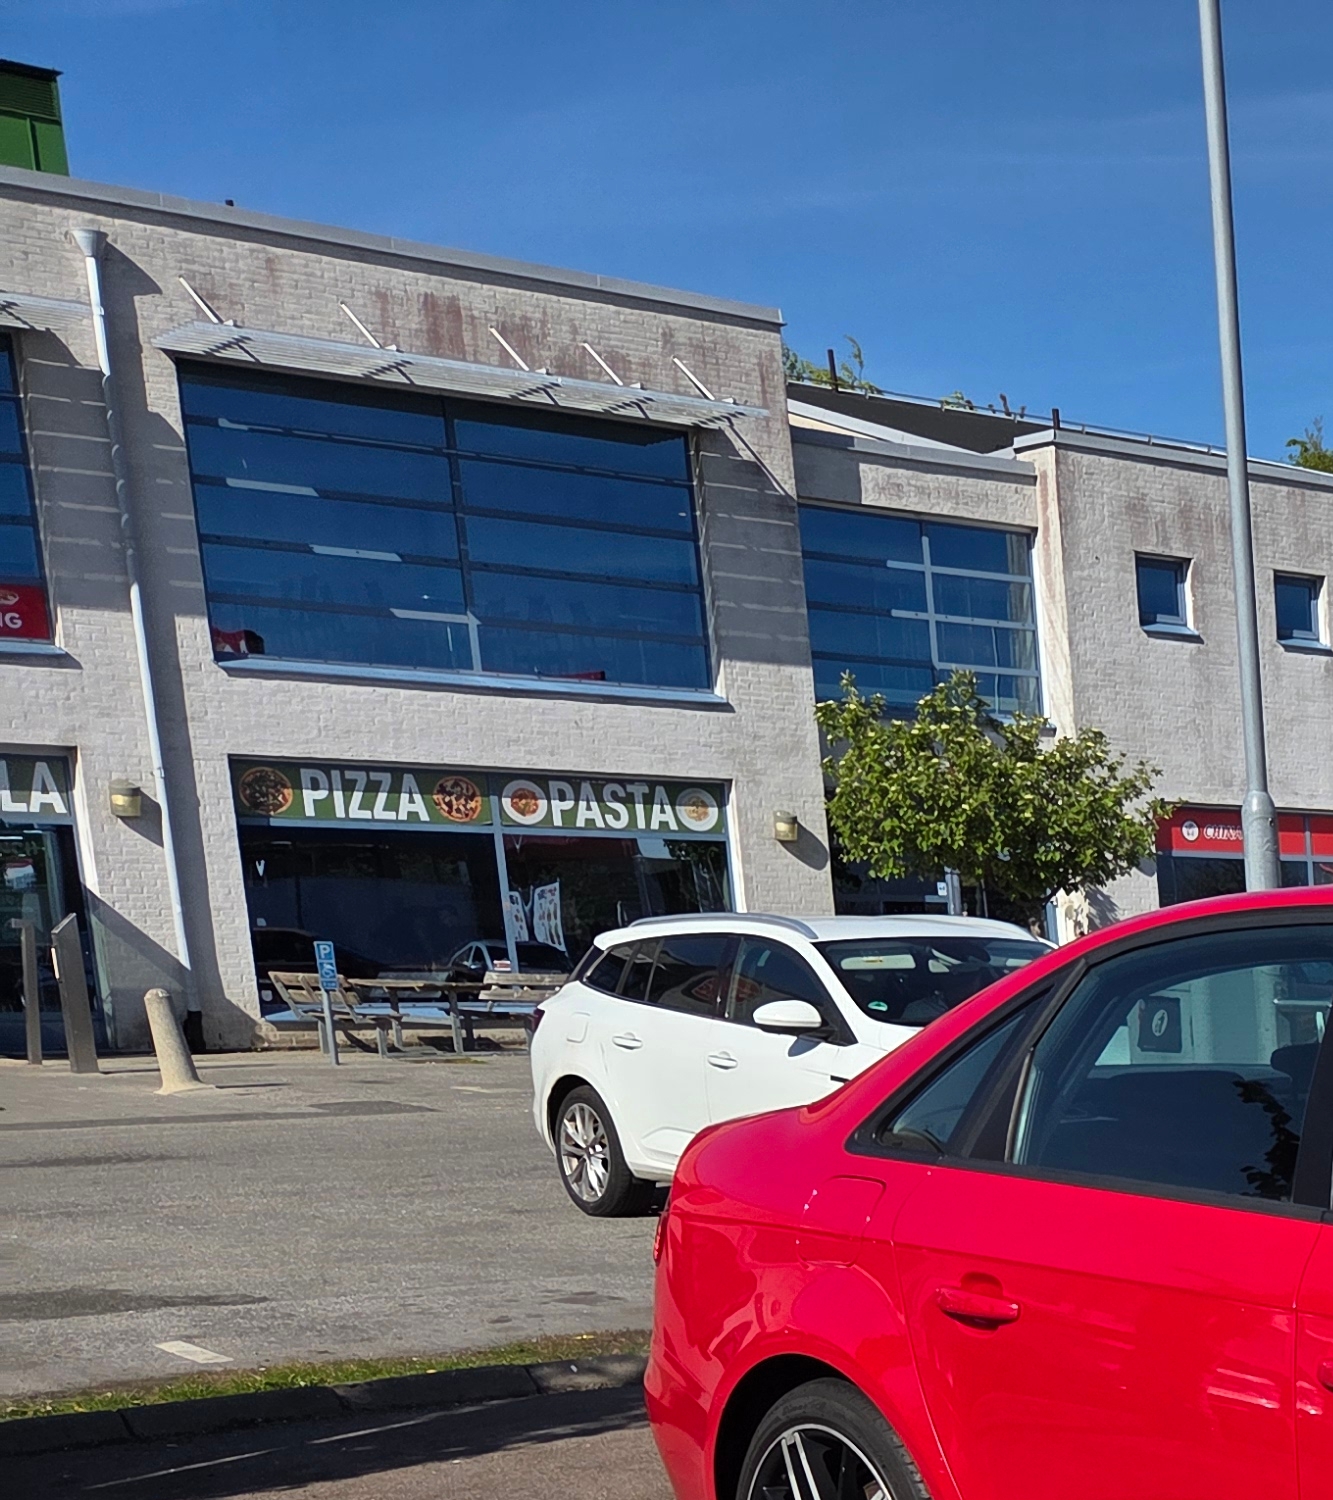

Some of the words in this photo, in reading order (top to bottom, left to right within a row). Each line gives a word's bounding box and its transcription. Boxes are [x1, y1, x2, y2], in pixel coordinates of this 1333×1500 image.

[0, 611, 23, 629] G
[300, 768, 431, 822] PIZZA
[548, 781, 679, 831] PASTA
[319, 944, 331, 959] P
